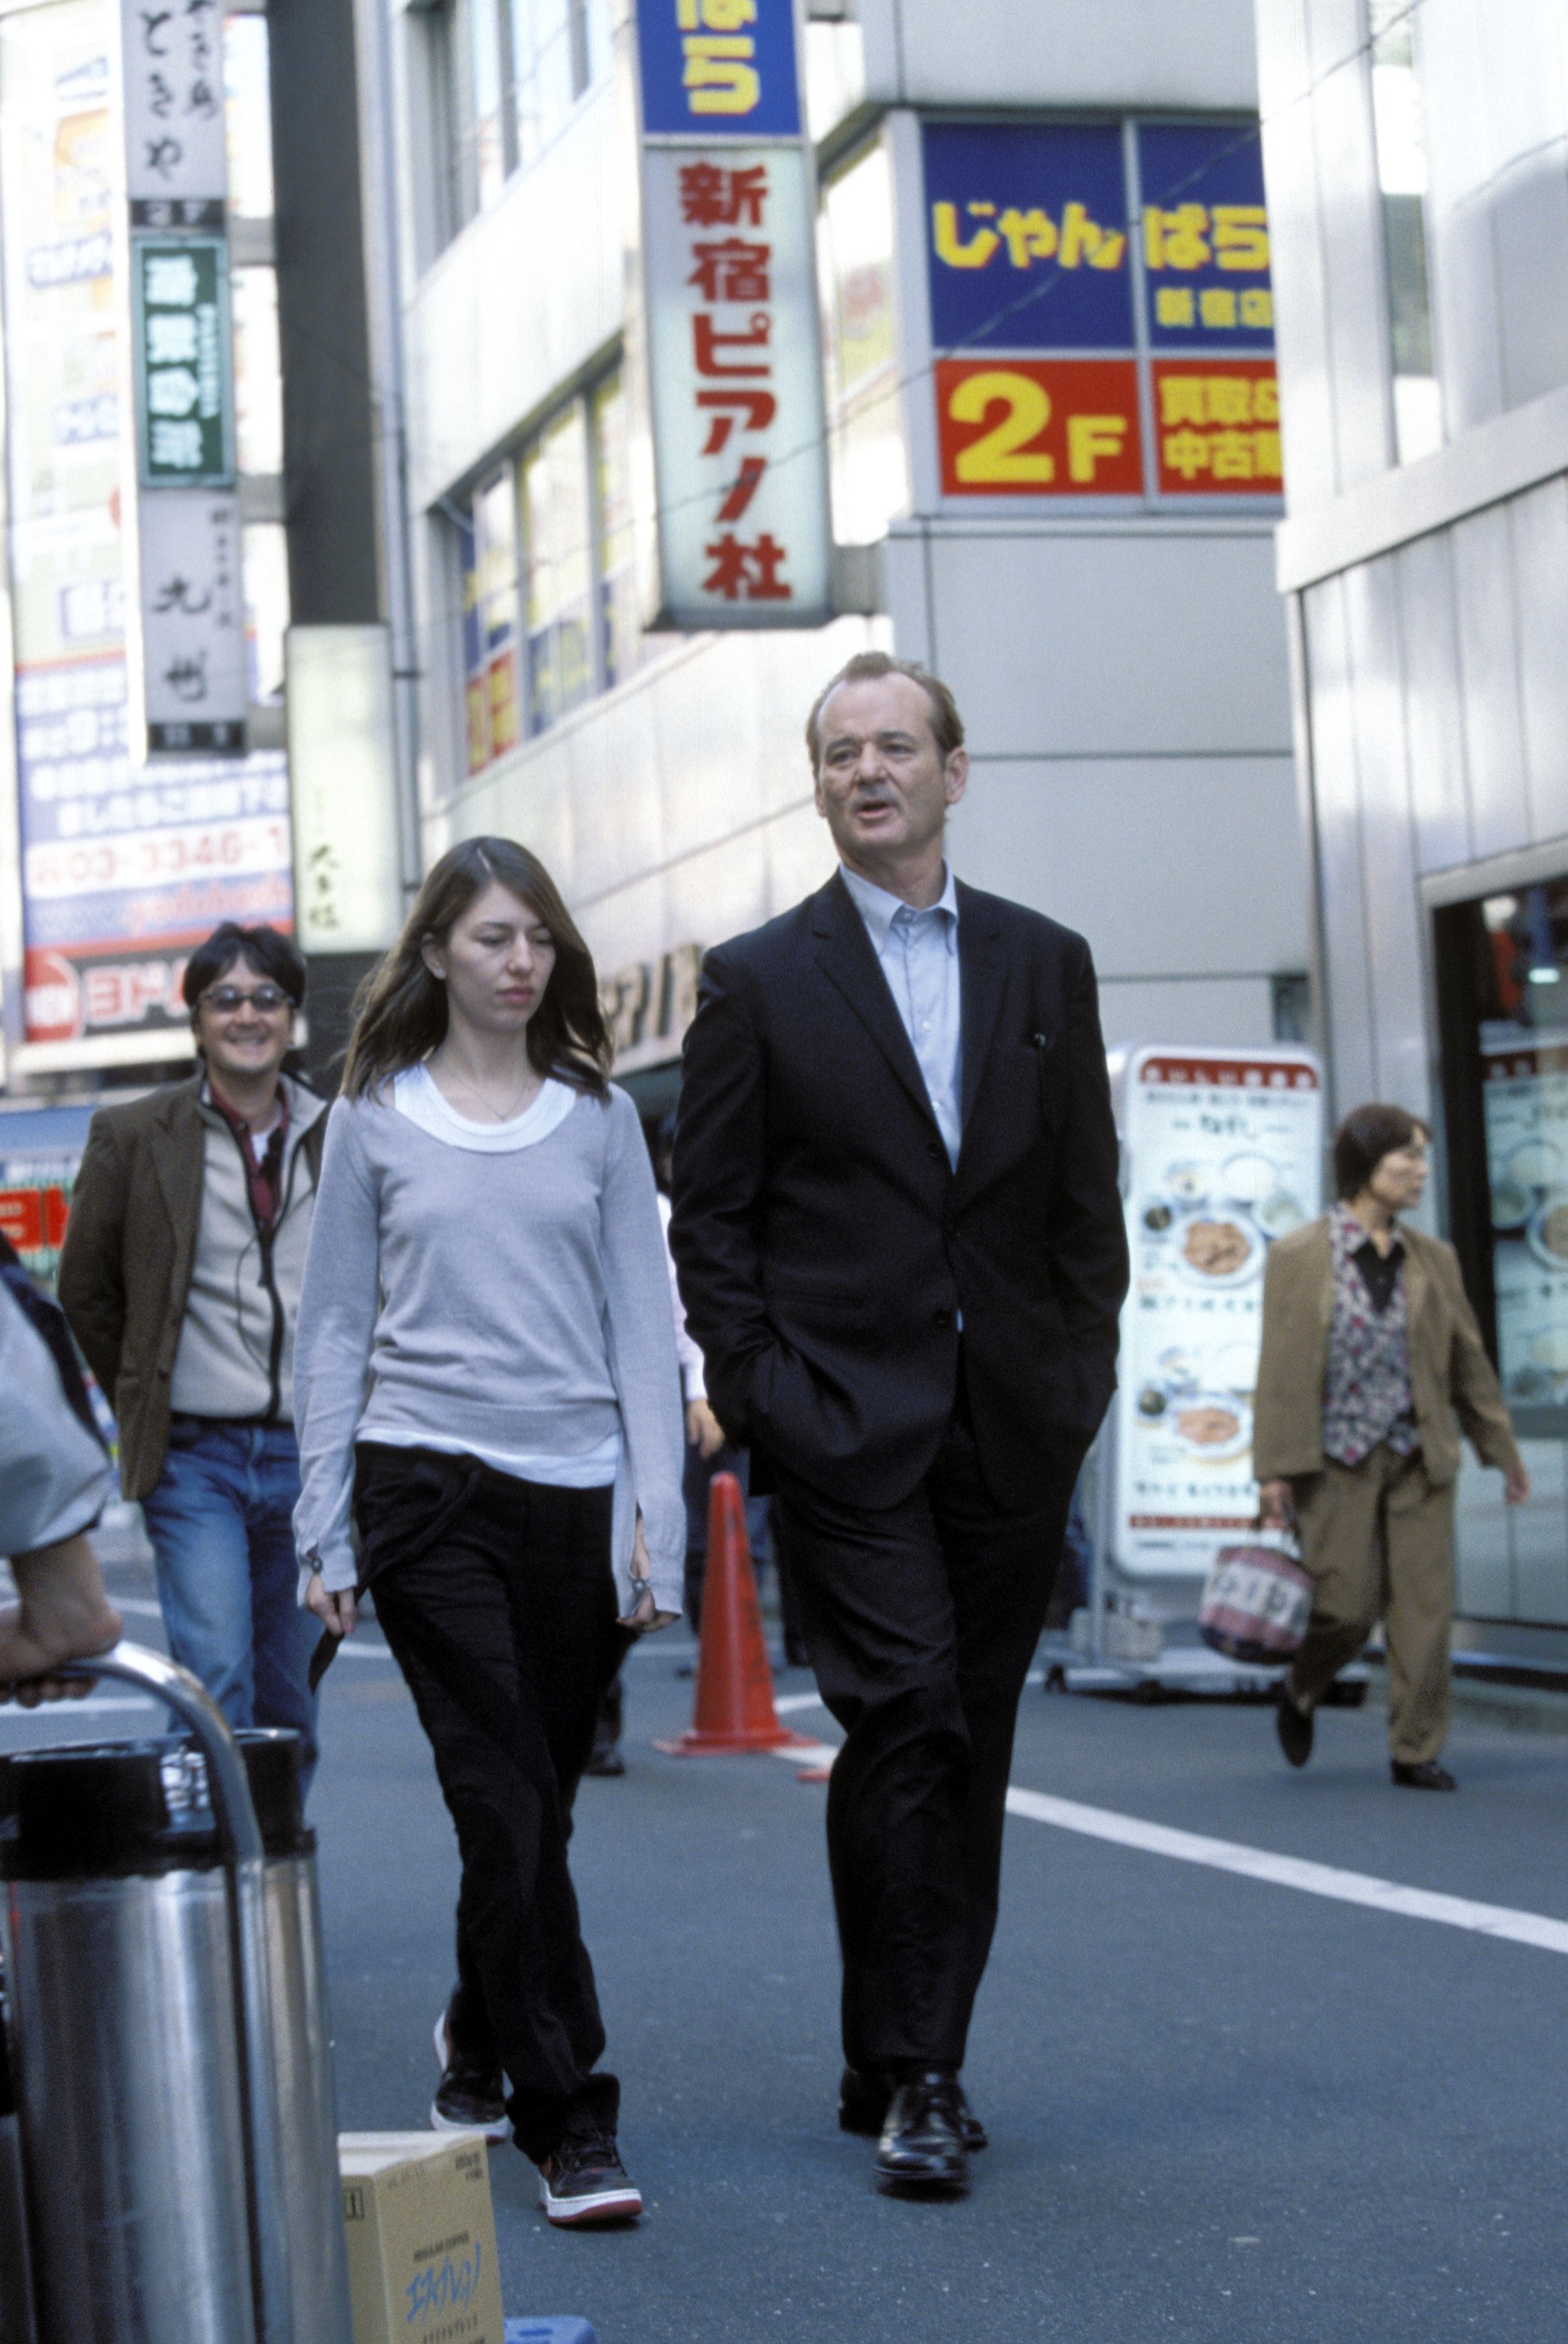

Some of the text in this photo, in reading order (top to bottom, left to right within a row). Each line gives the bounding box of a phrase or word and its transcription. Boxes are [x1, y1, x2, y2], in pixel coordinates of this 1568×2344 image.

[677, 162, 792, 600] 新宿ピアノ社
[949, 371, 1128, 484] 2F
